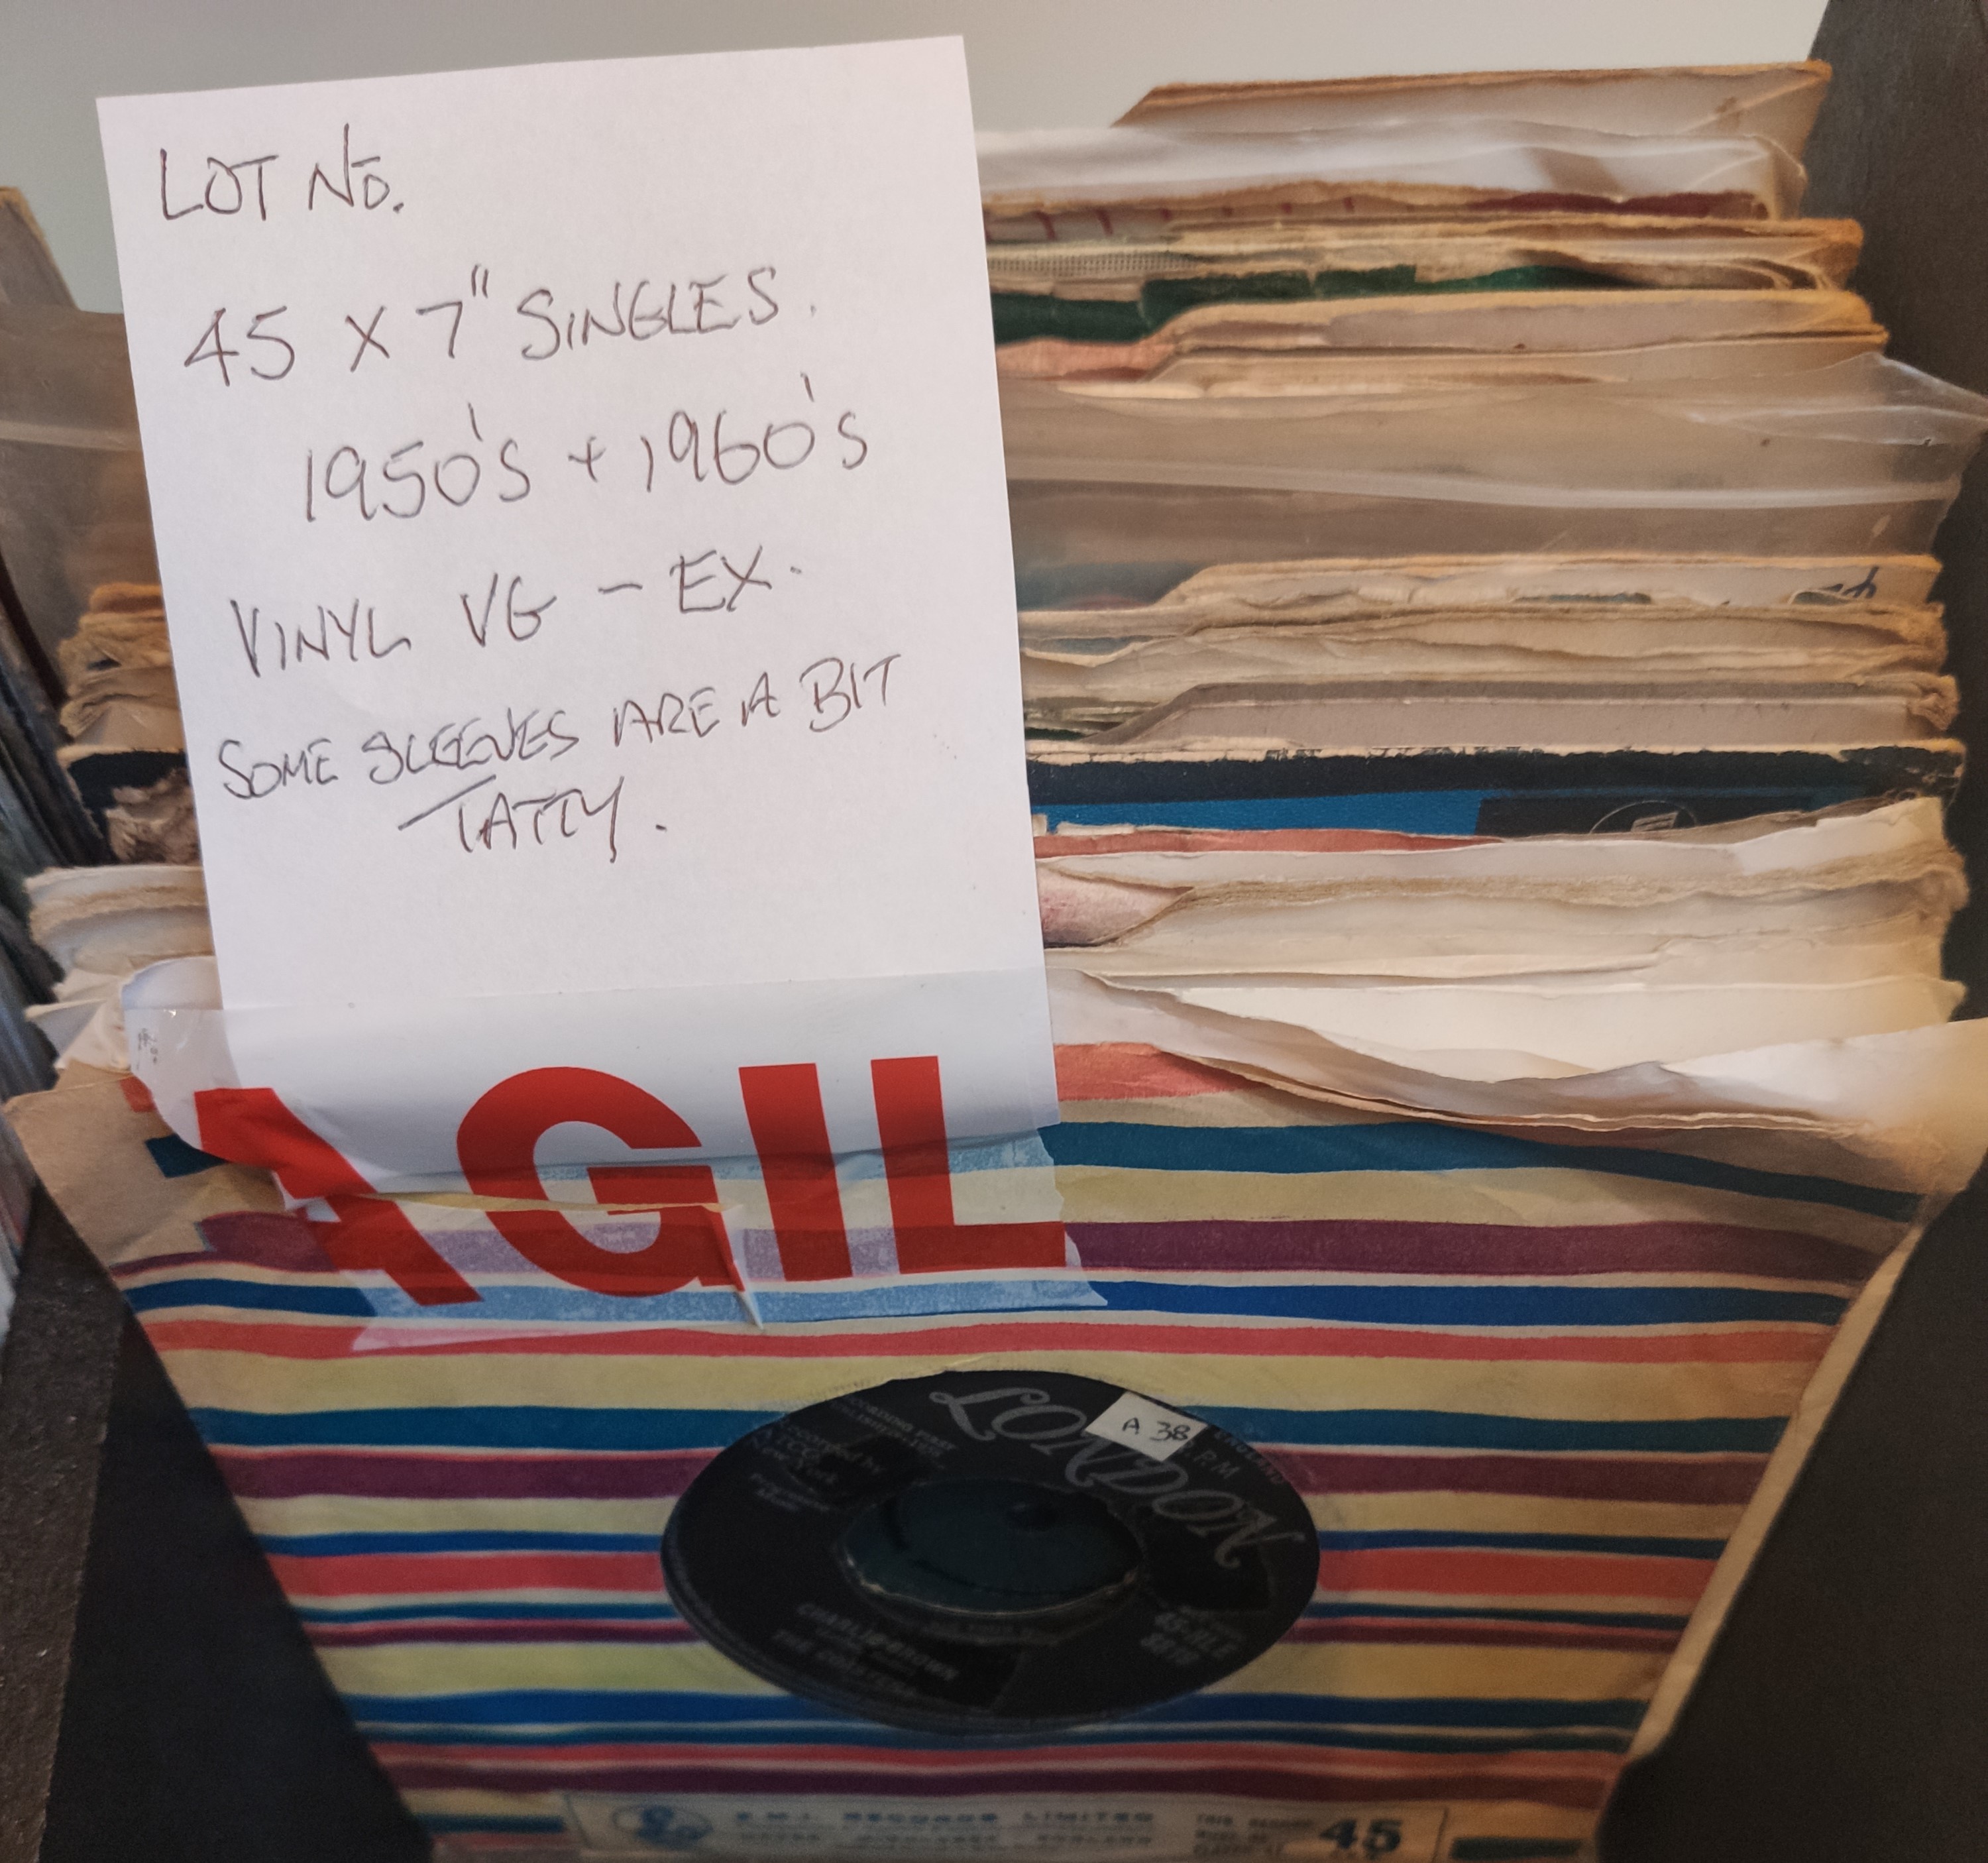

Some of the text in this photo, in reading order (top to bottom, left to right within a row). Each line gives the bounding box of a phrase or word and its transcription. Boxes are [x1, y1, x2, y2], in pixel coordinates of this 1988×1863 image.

[159, 147, 279, 222] LOT
[183, 305, 296, 388] 45
[229, 598, 412, 679] VINYL
[459, 572, 558, 648] VG
[217, 653, 902, 801] SOME SLEEVES ARE A BIT
[1123, 1416, 1191, 1443] A 38
[929, 1388, 1305, 1569] LONDON
[1319, 1819, 1404, 1857] 45
